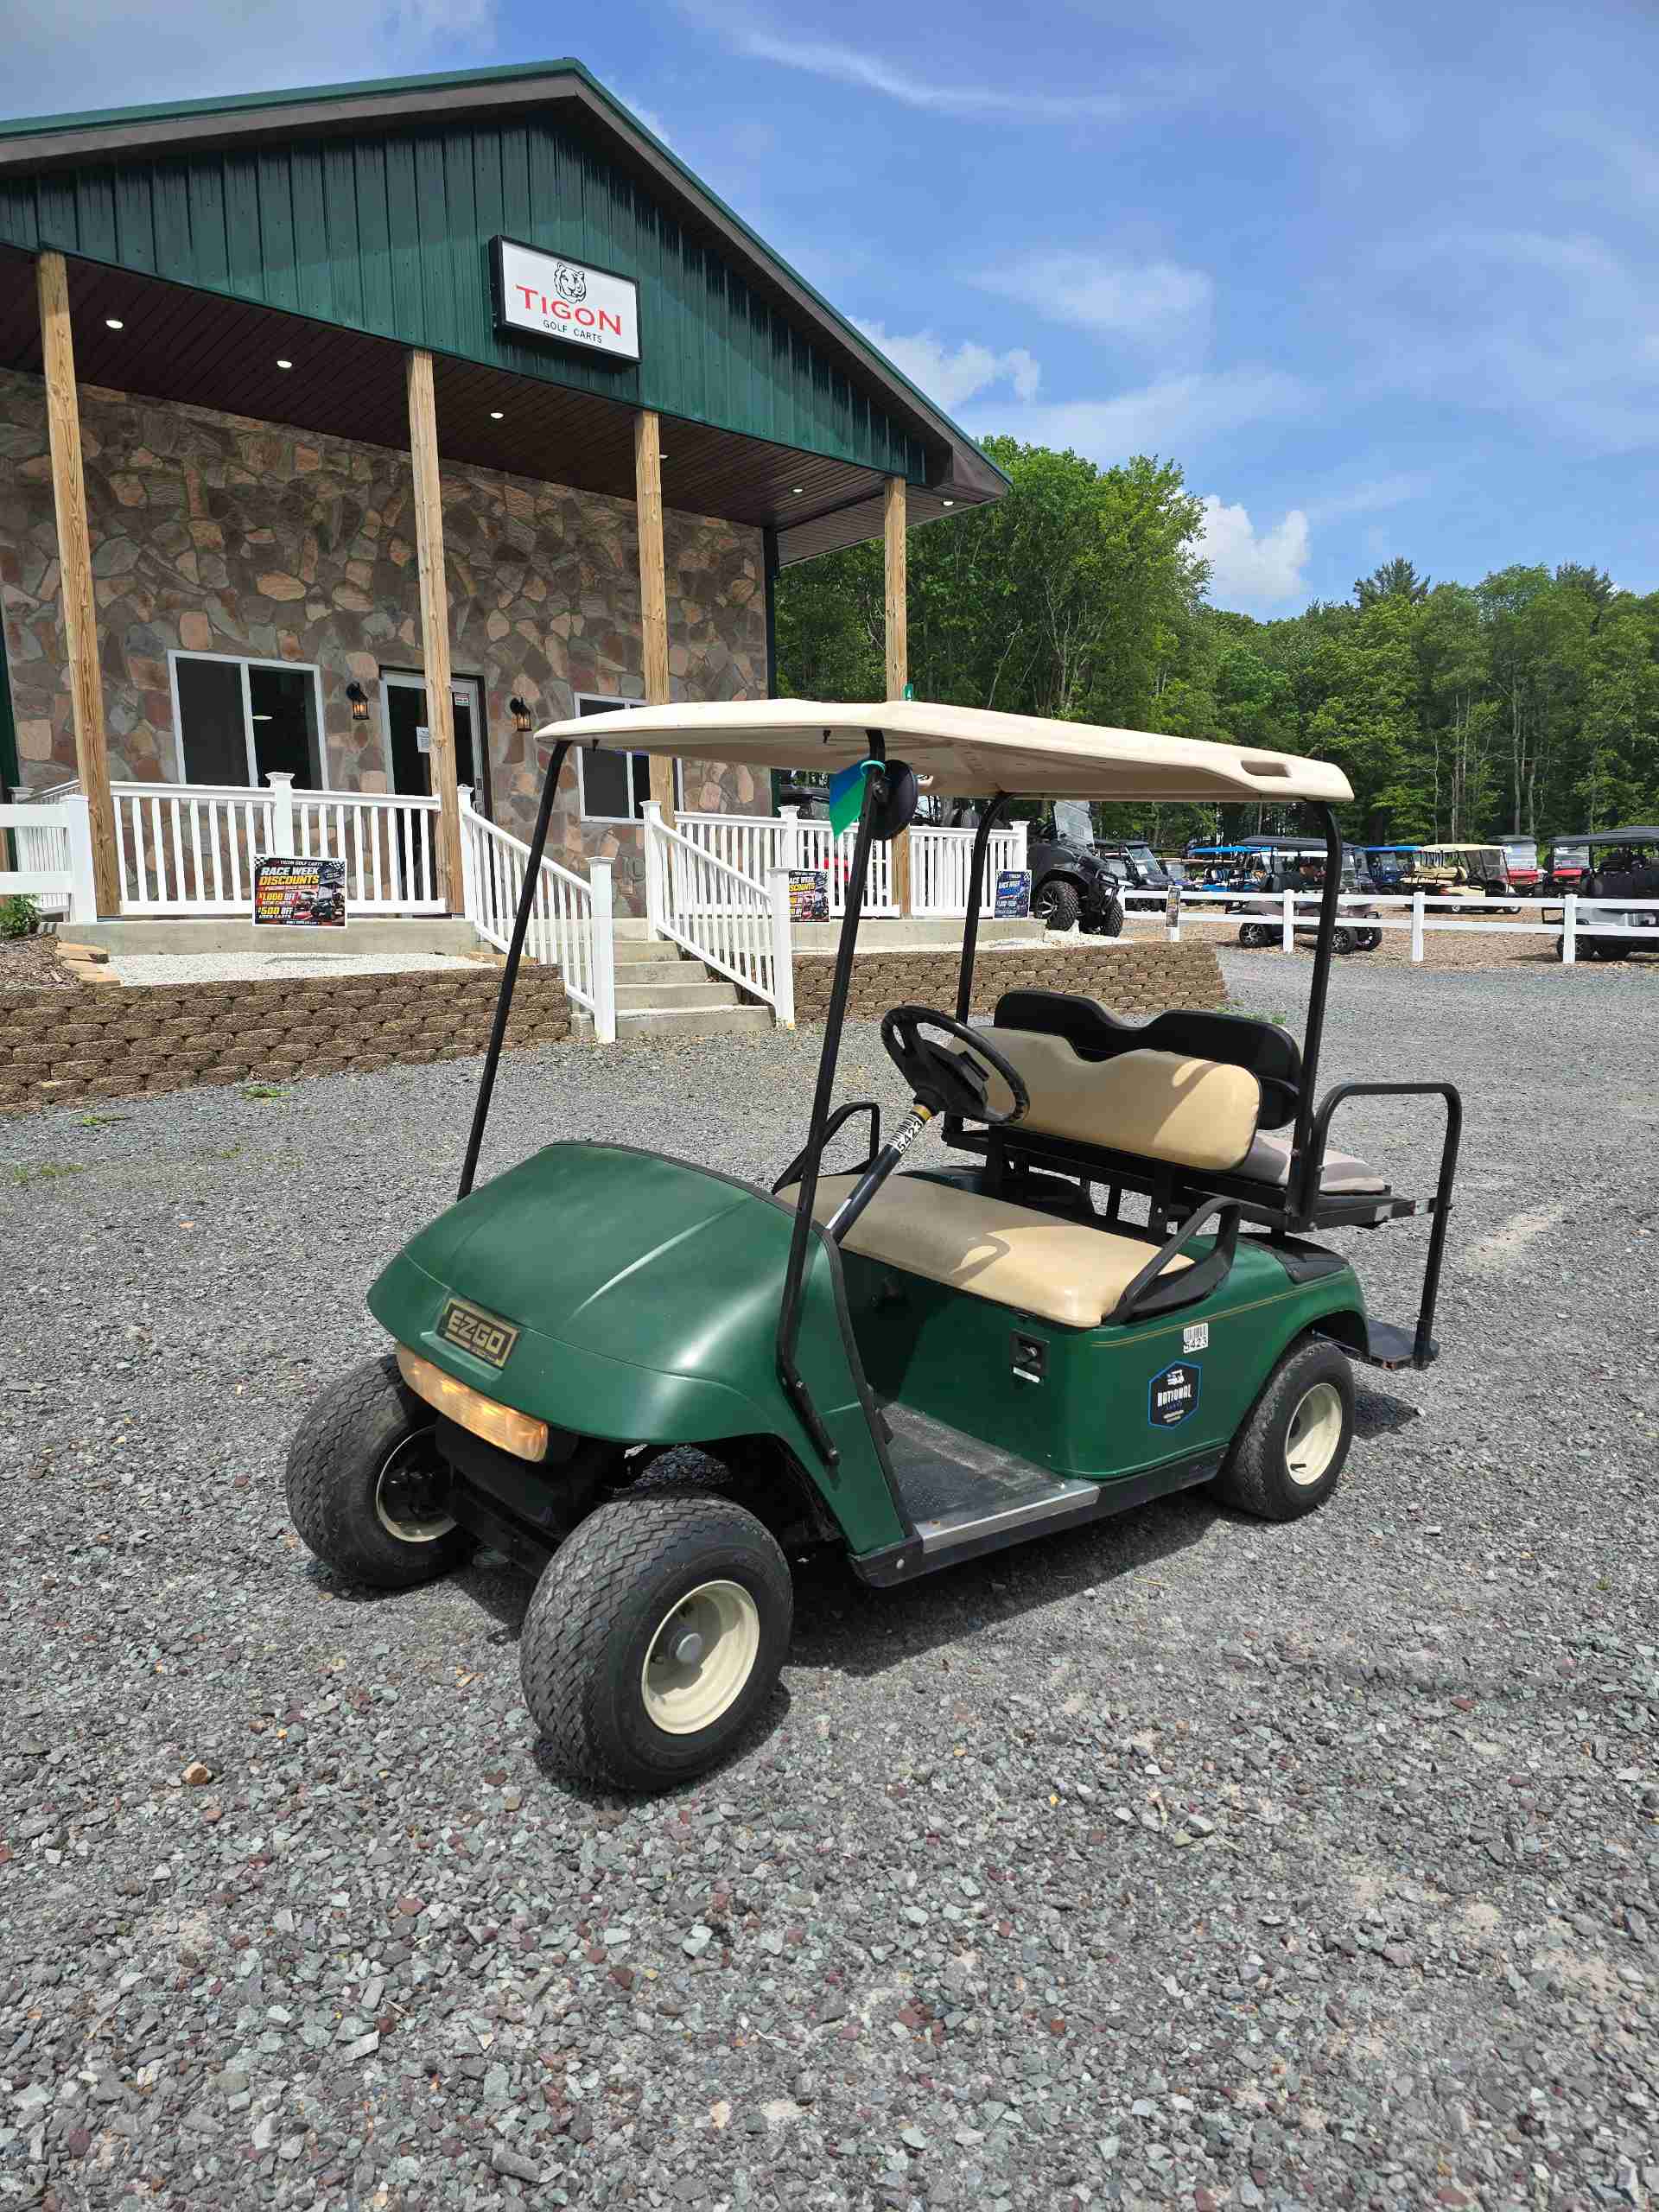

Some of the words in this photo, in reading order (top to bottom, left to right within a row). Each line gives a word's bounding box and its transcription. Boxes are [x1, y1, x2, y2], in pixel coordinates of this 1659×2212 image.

[516, 283, 622, 336] TIGON
[543, 319, 567, 333] GOLF
[573, 327, 602, 343] CARTS
[258, 875, 319, 885] DISCOUNTS
[261, 867, 290, 875] RACE
[292, 866, 320, 875] WEEK
[897, 1120, 921, 1154] 5423
[1183, 1336, 1208, 1351] 5423
[1157, 1383, 1192, 1408] NATIONAL
